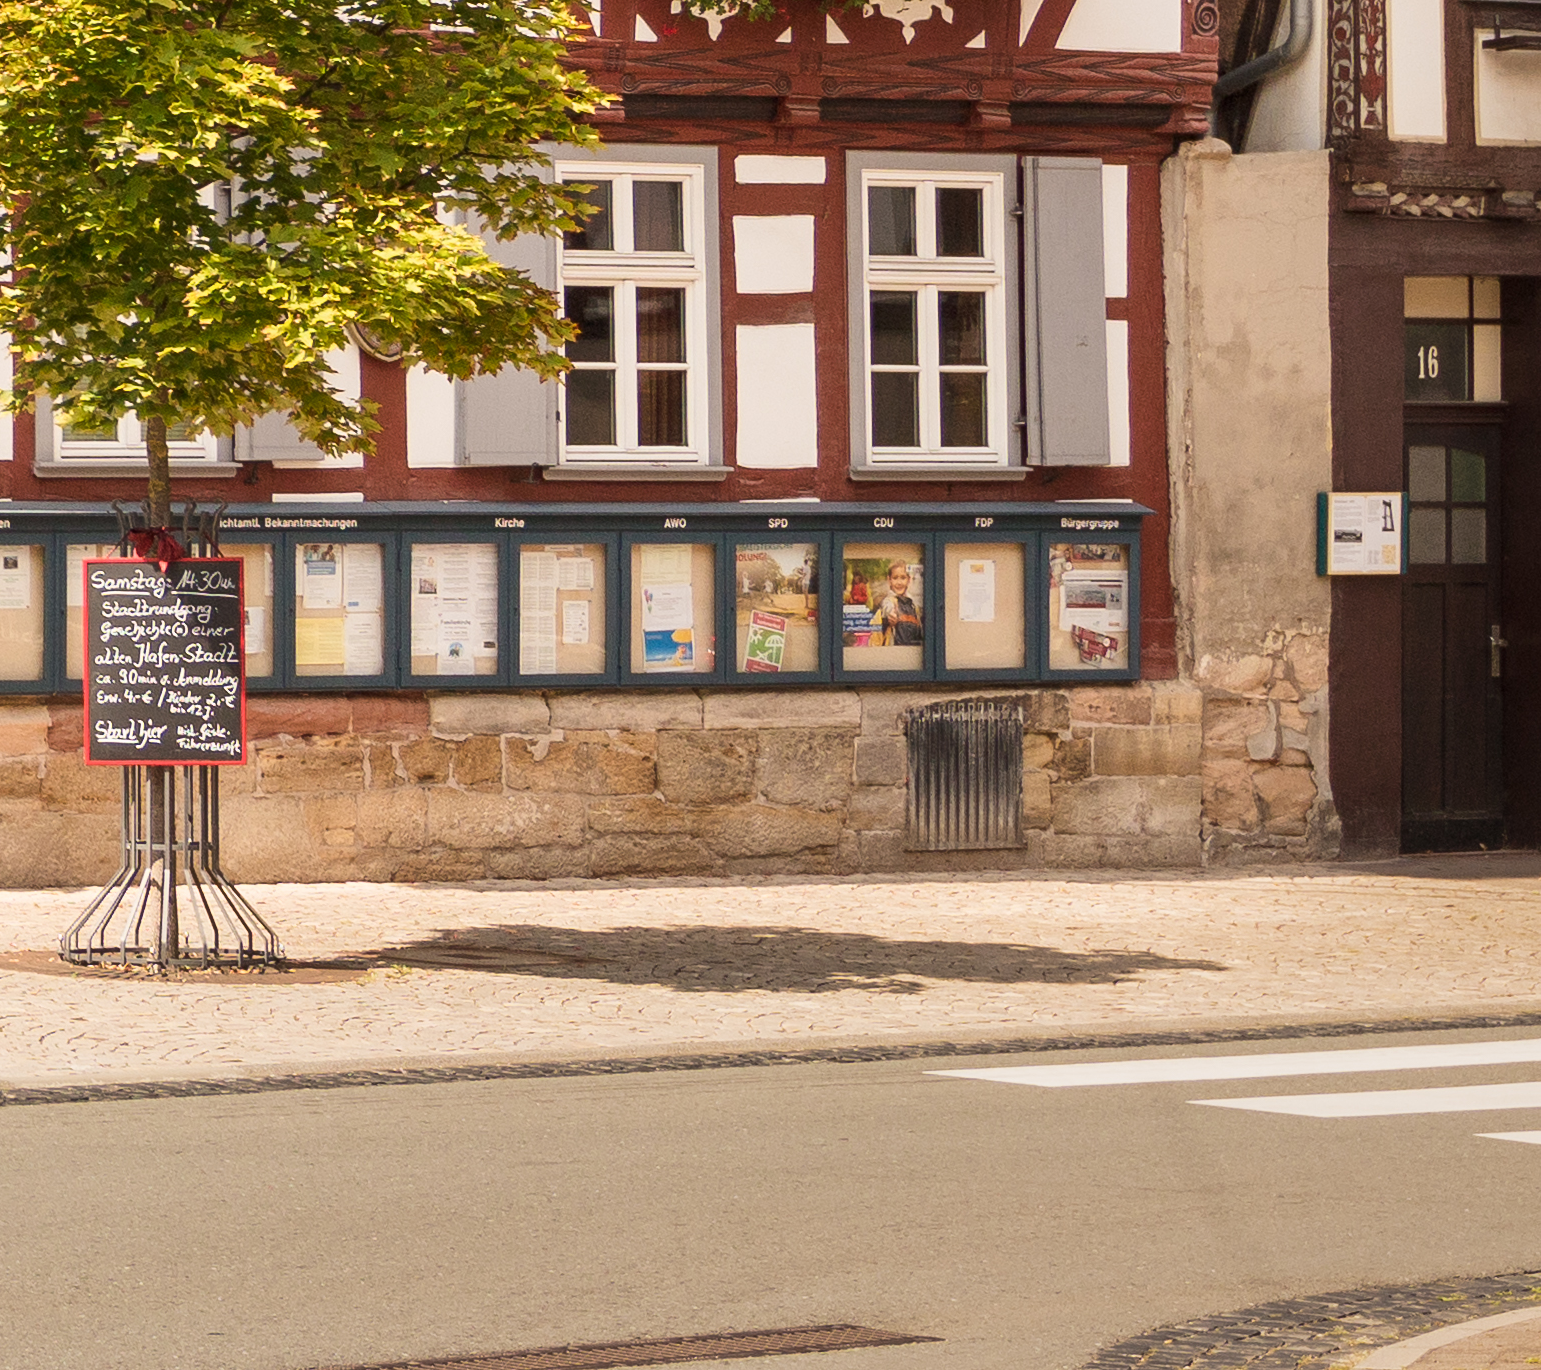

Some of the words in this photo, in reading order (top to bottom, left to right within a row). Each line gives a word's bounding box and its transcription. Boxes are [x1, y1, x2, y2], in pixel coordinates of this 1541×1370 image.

[1418, 345, 1439, 379] 16
[219, 517, 261, 529] ichtamtl.
[264, 517, 358, 531] Bekanntmachungen
[494, 517, 525, 529] Kirche
[664, 517, 687, 529] AWO
[768, 517, 789, 529] SPD
[873, 517, 894, 528] CDU
[975, 517, 994, 528] FDP
[1060, 517, 1120, 531] Bürgergruppe
[191, 626, 235, 638] einer
[94, 646, 133, 666] alten
[95, 674, 116, 684] ca.
[173, 667, 239, 695] Anmeldung
[95, 718, 137, 740] Start
